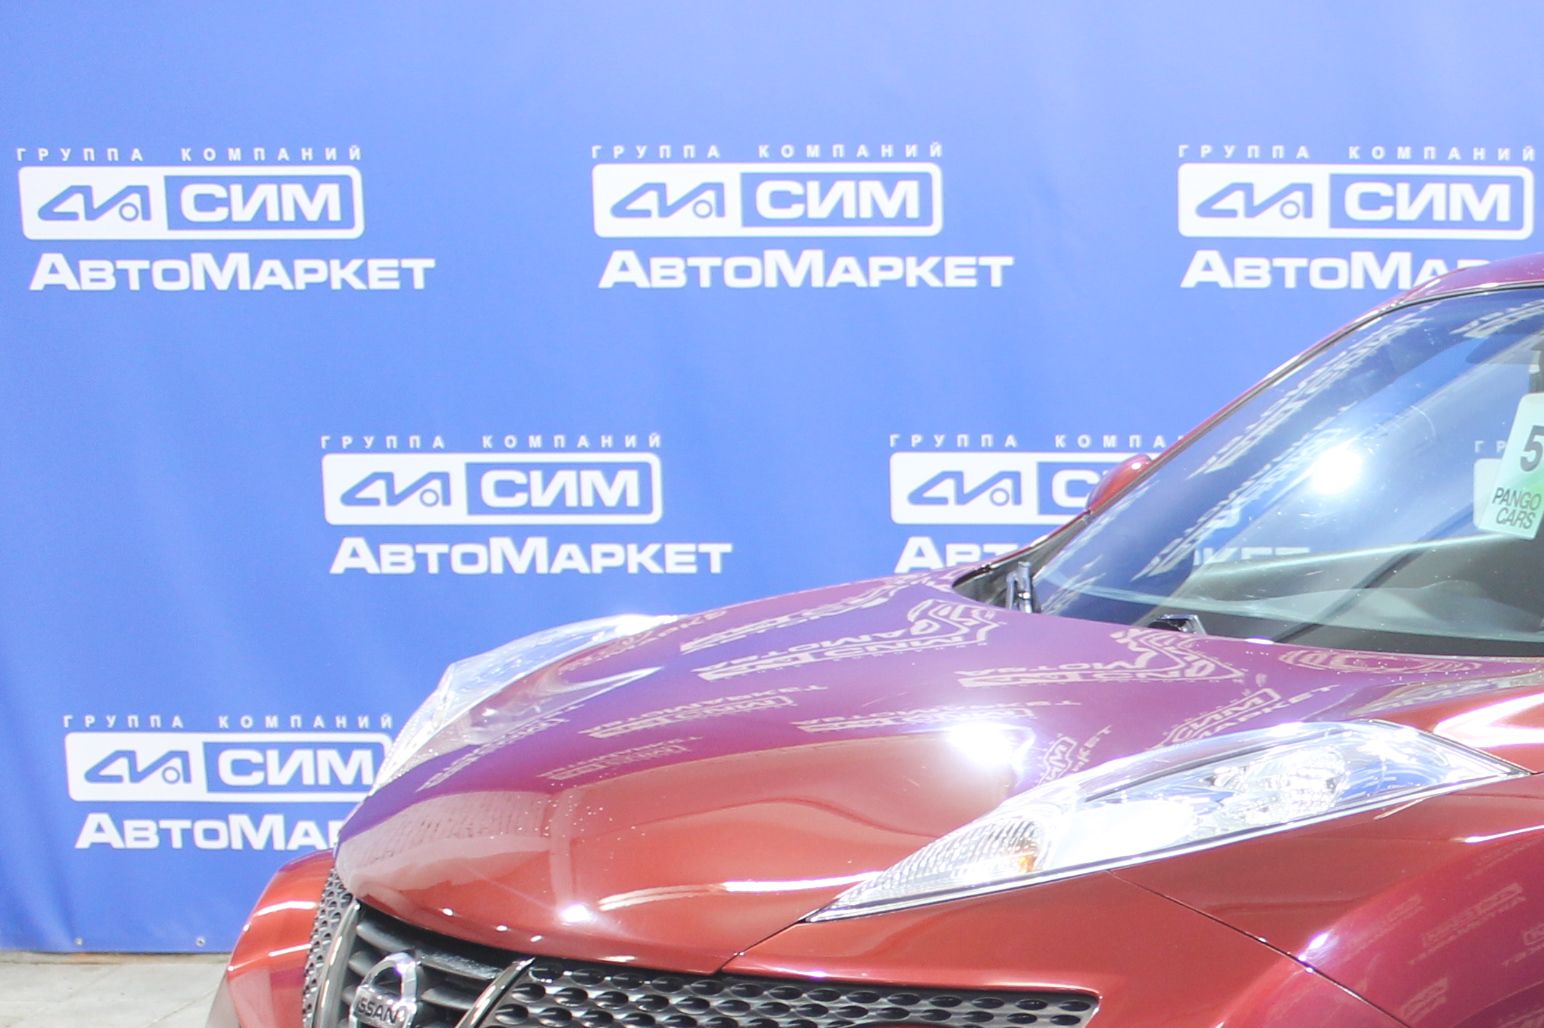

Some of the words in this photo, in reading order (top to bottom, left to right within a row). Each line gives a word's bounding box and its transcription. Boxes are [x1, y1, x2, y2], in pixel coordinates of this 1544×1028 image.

[17, 148, 144, 161] ГРУППА
[181, 145, 361, 161] КОМПАНИЙ
[592, 145, 720, 159] ГРУППА
[759, 142, 942, 158] КОМПАНИЙ
[1179, 145, 1311, 160] ГРУППА
[1349, 144, 1535, 161] КОМПАНИЙ
[181, 184, 340, 221] СИМ
[756, 181, 918, 219] СИМ
[1345, 182, 1511, 222] СИМ
[320, 435, 445, 448] ГРУППА
[483, 432, 661, 448] КОМПАНИЙ
[890, 434, 1017, 448] ГРУППА
[1056, 434, 1182, 450] КОМПА
[481, 470, 640, 507] СИМ
[1492, 487, 1542, 511] PANGO
[1496, 507, 1536, 529] CARS
[63, 714, 184, 728] ГРУППА
[219, 714, 393, 728] КОМПАНИЙ
[218, 749, 374, 786] СИМ
